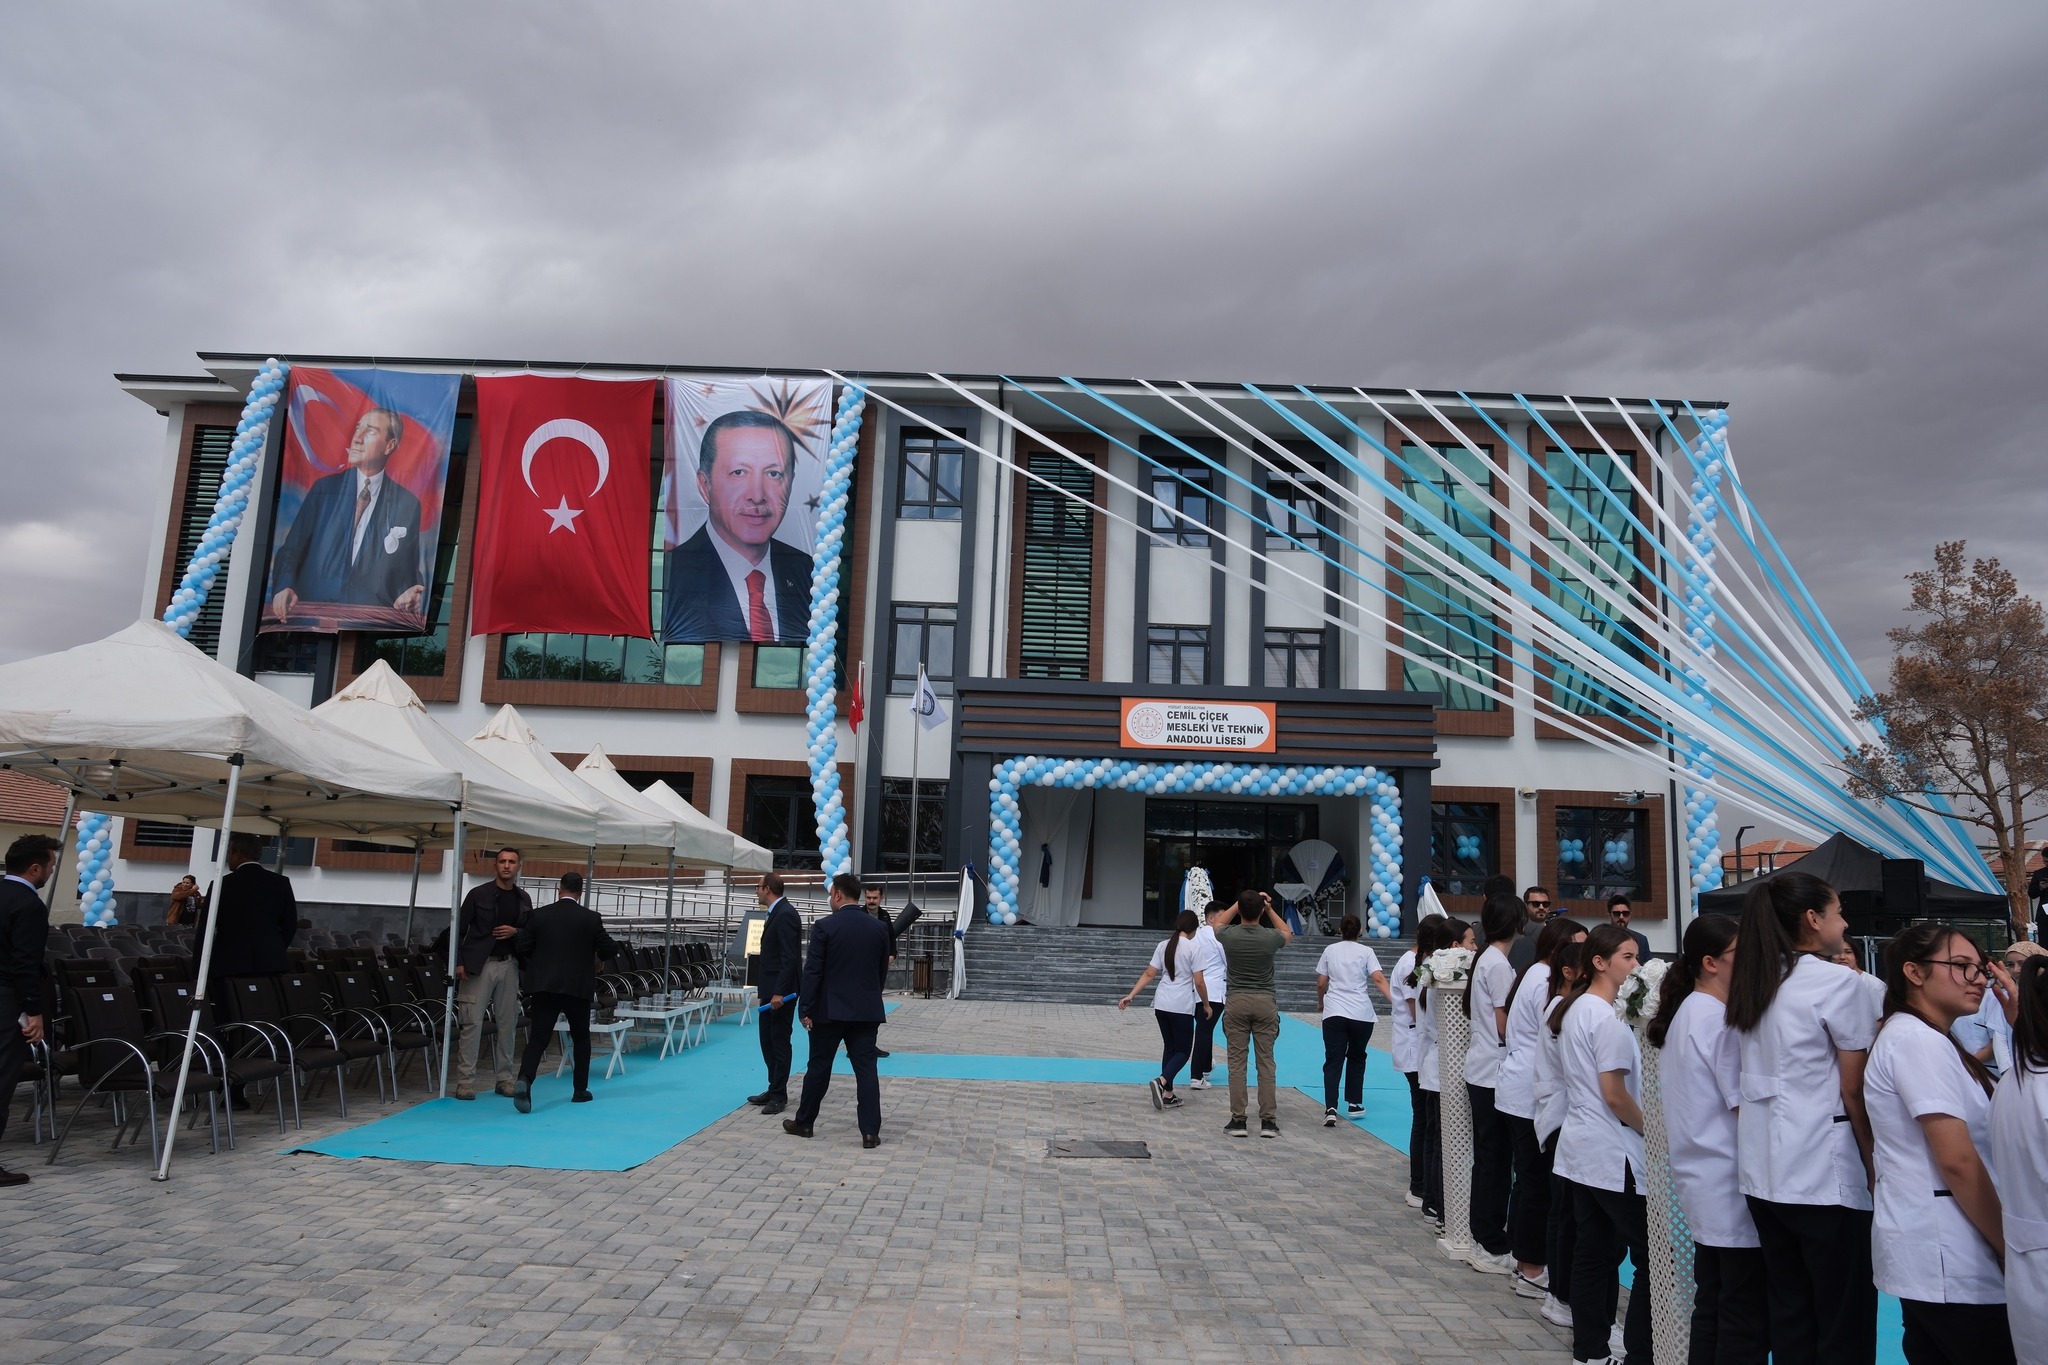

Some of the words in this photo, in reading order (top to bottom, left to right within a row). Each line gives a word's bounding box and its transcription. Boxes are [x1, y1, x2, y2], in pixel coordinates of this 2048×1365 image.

[1167, 710, 1196, 720] CEMİL
[1200, 710, 1228, 722] ÇİÇEK
[1166, 722, 1208, 732] MESLEKİ
[1212, 724, 1224, 733] VE
[1228, 724, 1264, 734] TEKNİK
[1166, 734, 1212, 744] ANADOLU
[1216, 735, 1246, 746] LİSESİ
